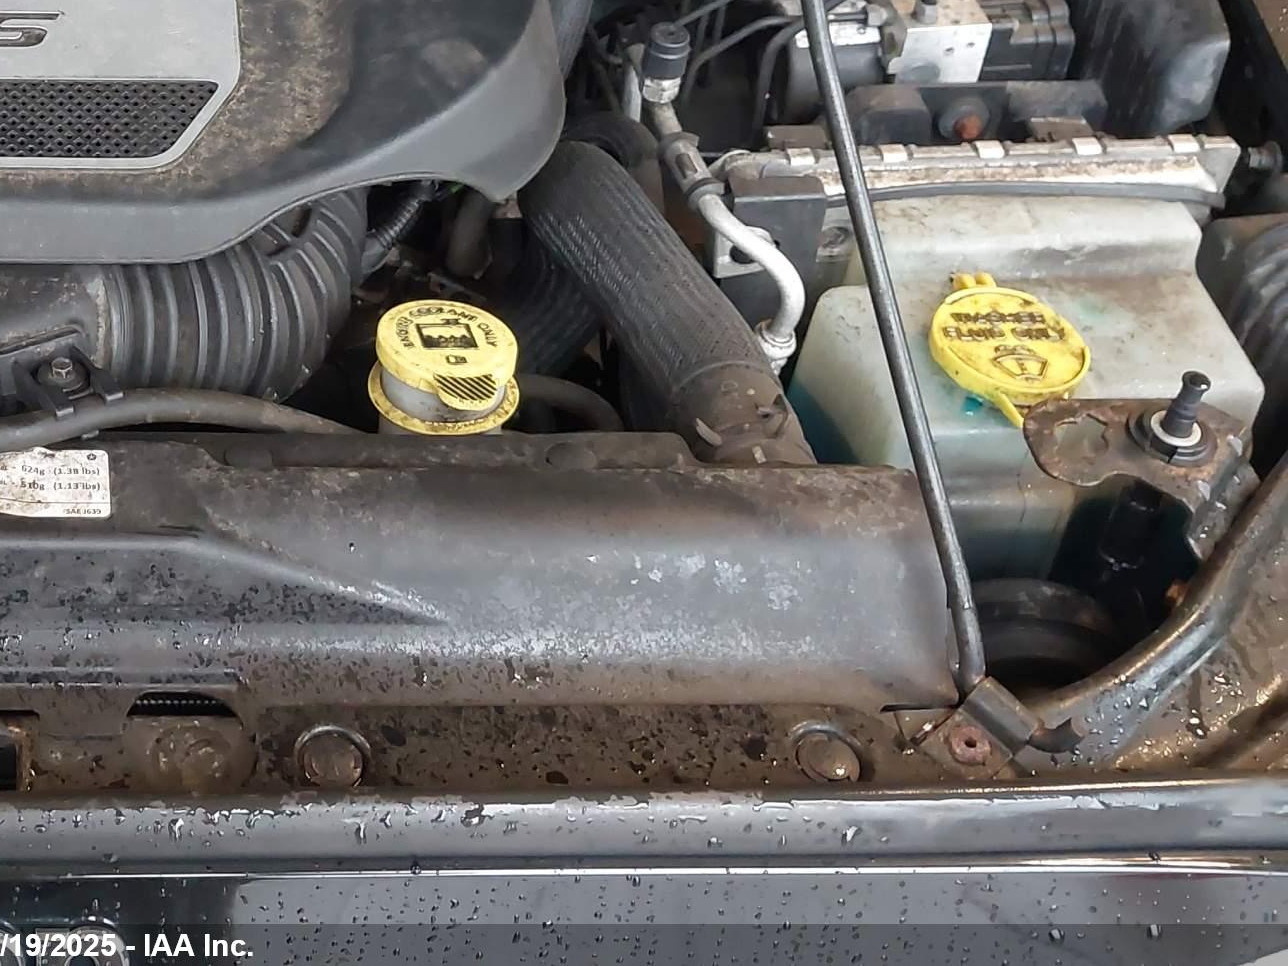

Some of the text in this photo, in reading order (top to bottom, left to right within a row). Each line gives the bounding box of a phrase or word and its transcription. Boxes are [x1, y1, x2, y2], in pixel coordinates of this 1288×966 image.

[950, 311, 1046, 325] WASHER
[942, 326, 1065, 341] FLUID ONLY
[22, 464, 45, 475] 624g
[53, 466, 79, 475] (1.38
[82, 466, 100, 475] lbs)
[82, 481, 101, 491] lbs)
[65, 507, 82, 515] SAE
